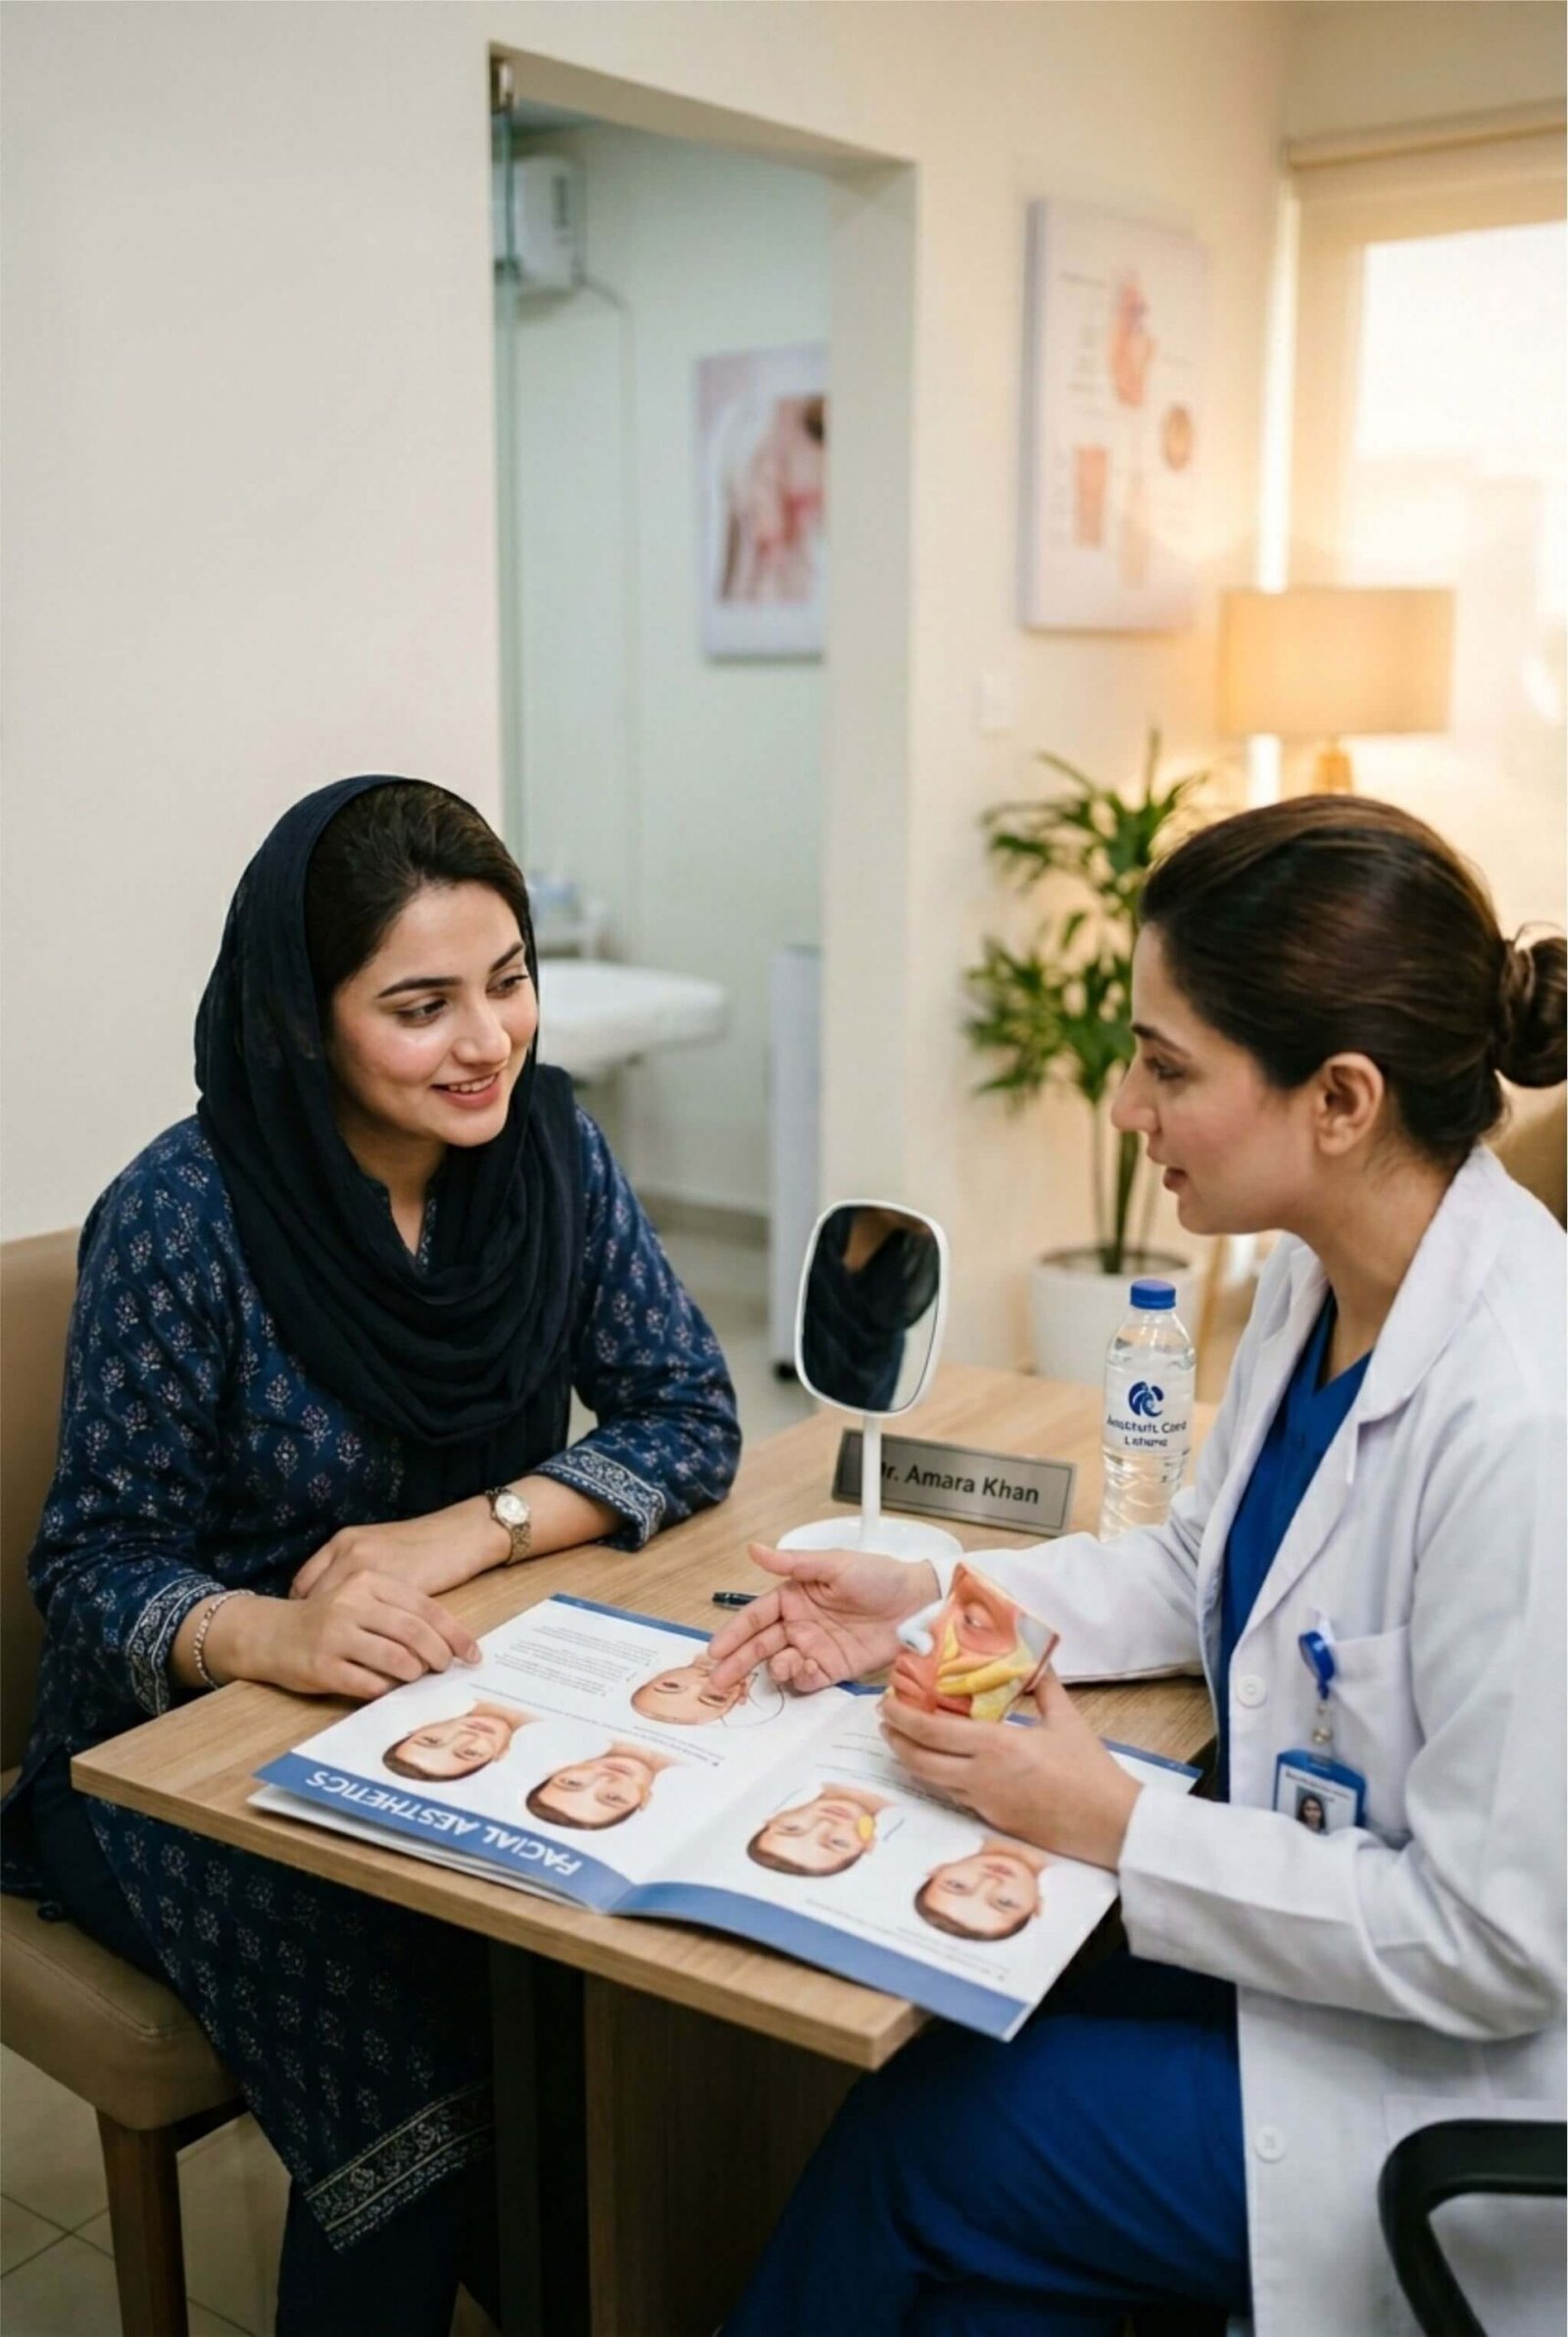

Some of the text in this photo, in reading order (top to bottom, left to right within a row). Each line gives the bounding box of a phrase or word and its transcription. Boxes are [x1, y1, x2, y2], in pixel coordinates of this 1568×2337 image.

[905, 1465, 975, 1494] Amara
[981, 1477, 1040, 1505] Khan
[306, 1770, 583, 1876] FACIAL AESTHETICS
